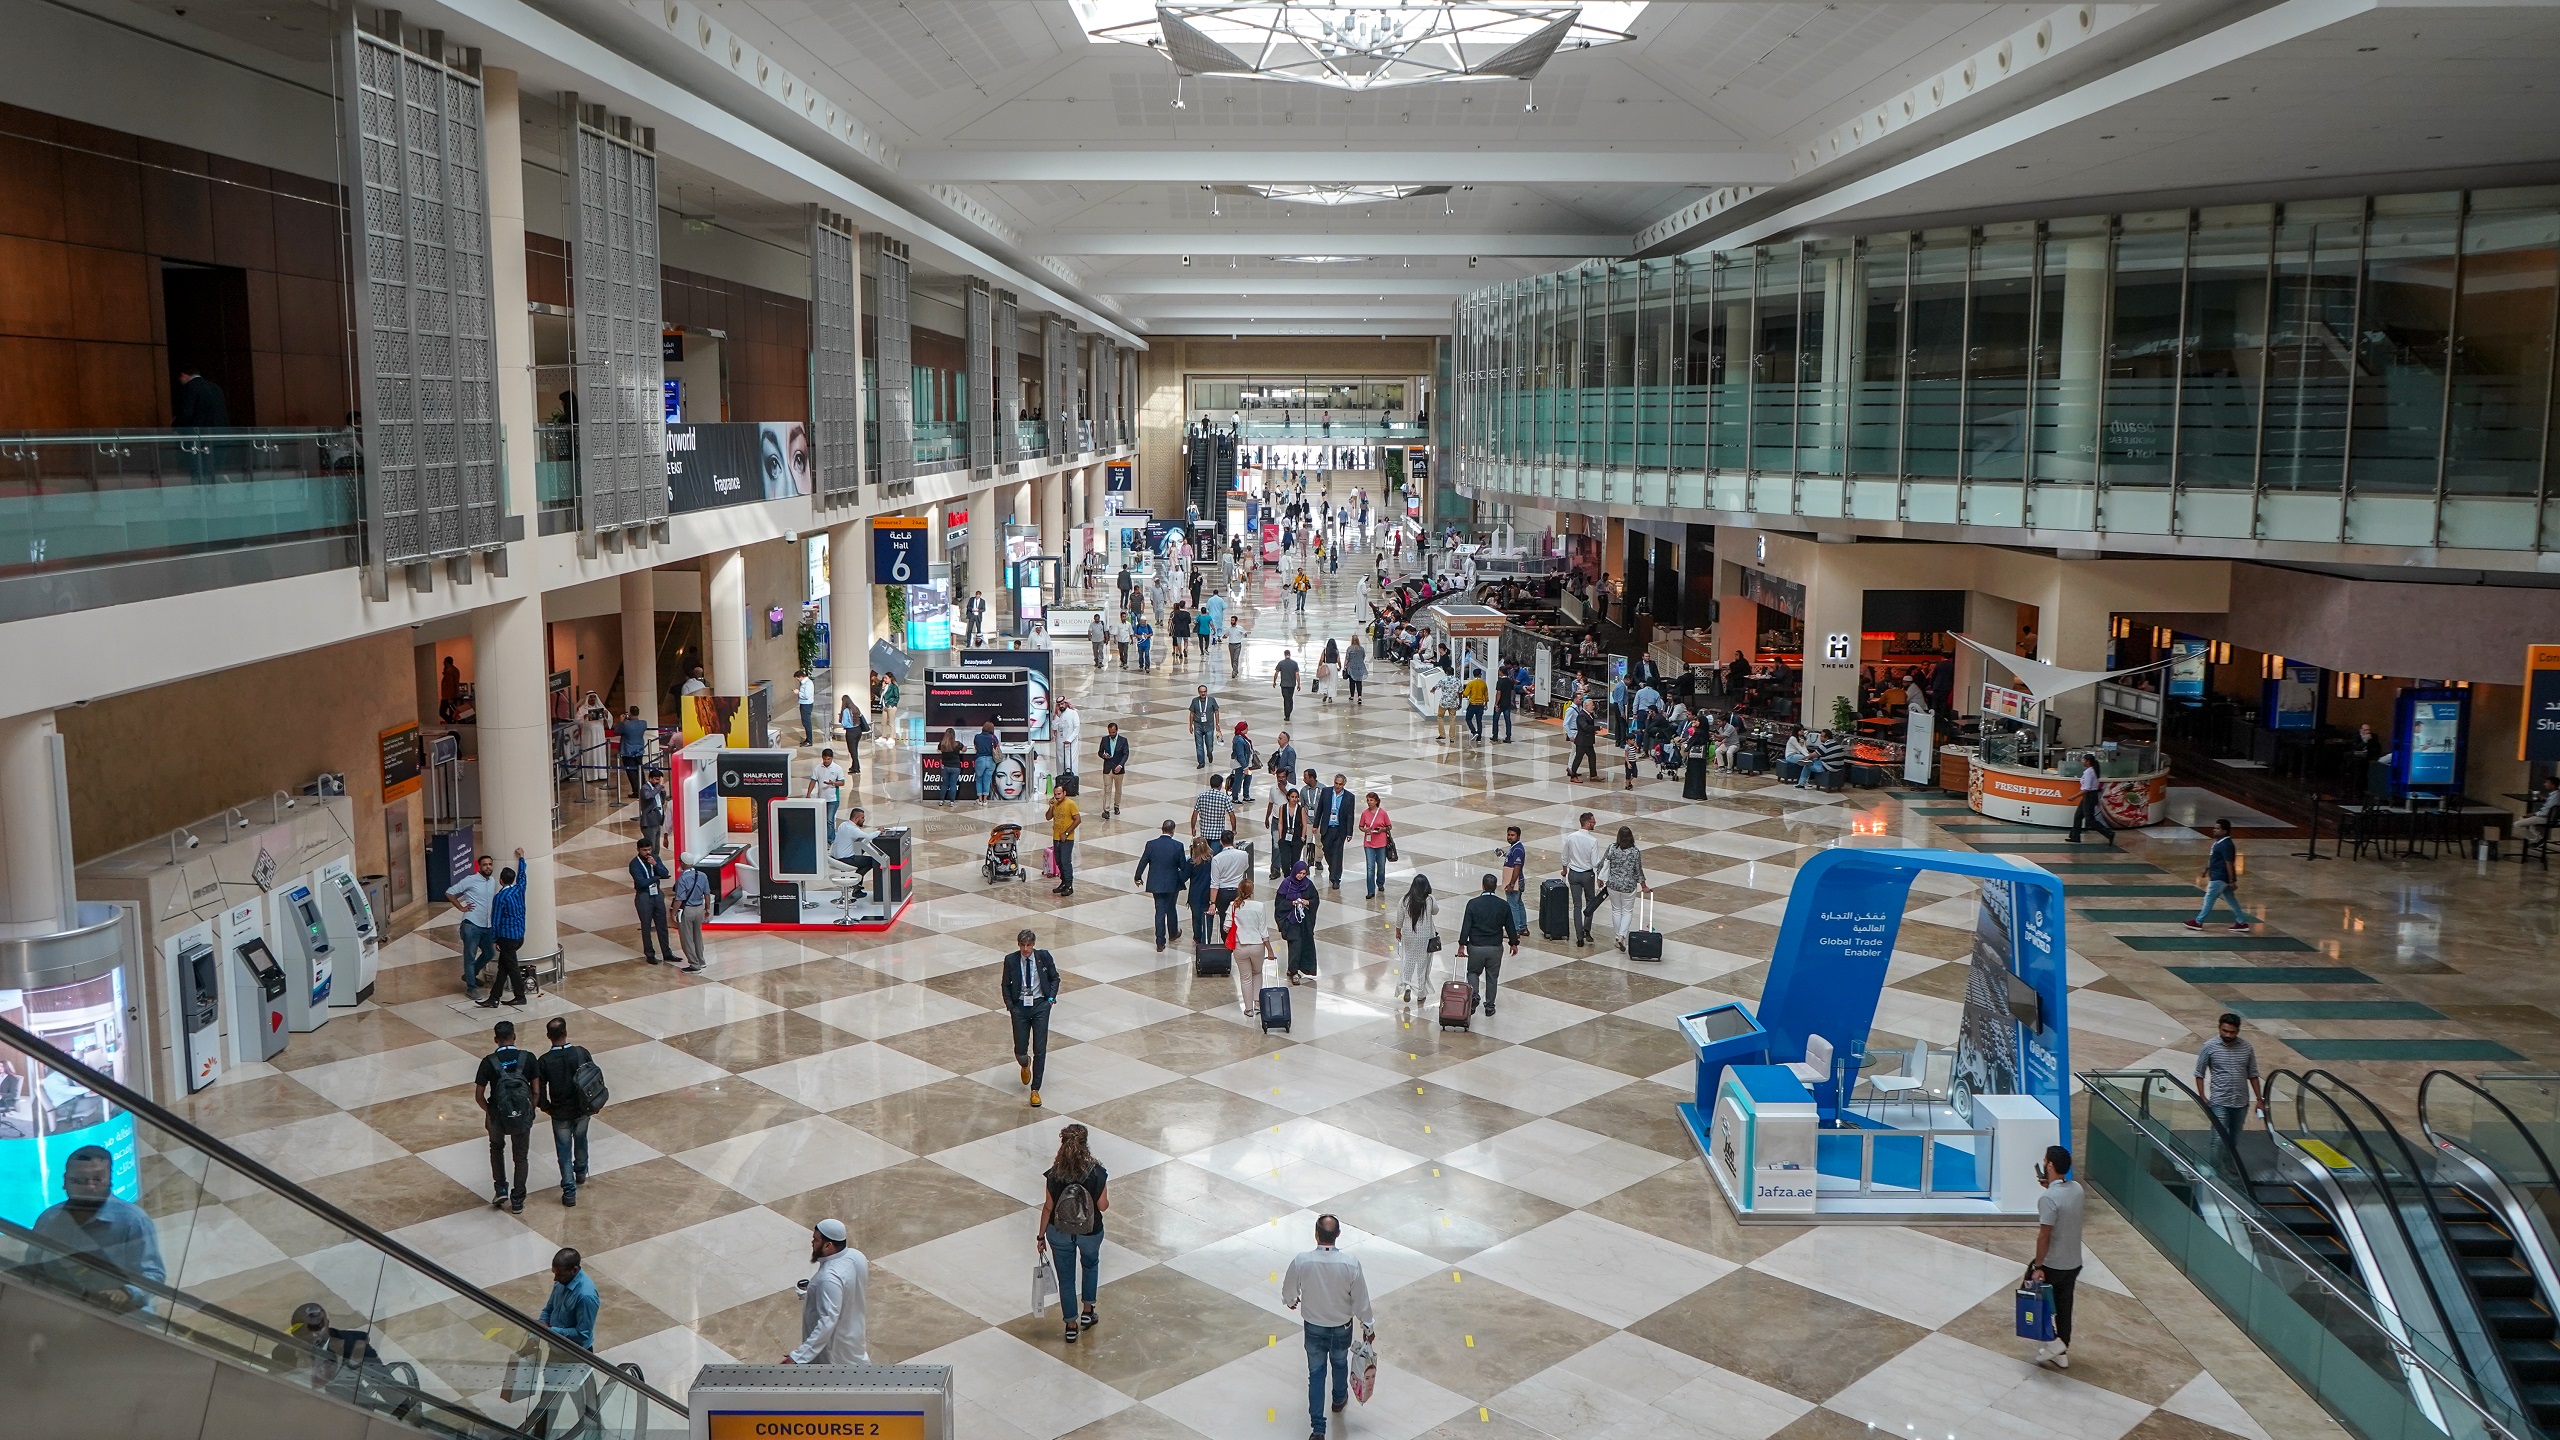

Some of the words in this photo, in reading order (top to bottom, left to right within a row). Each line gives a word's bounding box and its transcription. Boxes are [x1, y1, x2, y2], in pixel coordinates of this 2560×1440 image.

[671, 462, 683, 474] EAST
[713, 474, 740, 495] Fragrance
[1115, 476, 1124, 490] 7
[890, 531, 912, 540] قاعة
[892, 551, 910, 582] 6
[1995, 781, 2026, 794] FRESH
[2028, 788, 2062, 798] PIZZA
[1821, 912, 1853, 921] التجارة
[1853, 925, 1885, 933] العالمية
[1758, 1186, 1812, 1197] Jafza.ae
[755, 1423, 864, 1436] CONCOURSE
[870, 1423, 880, 1435] 2
